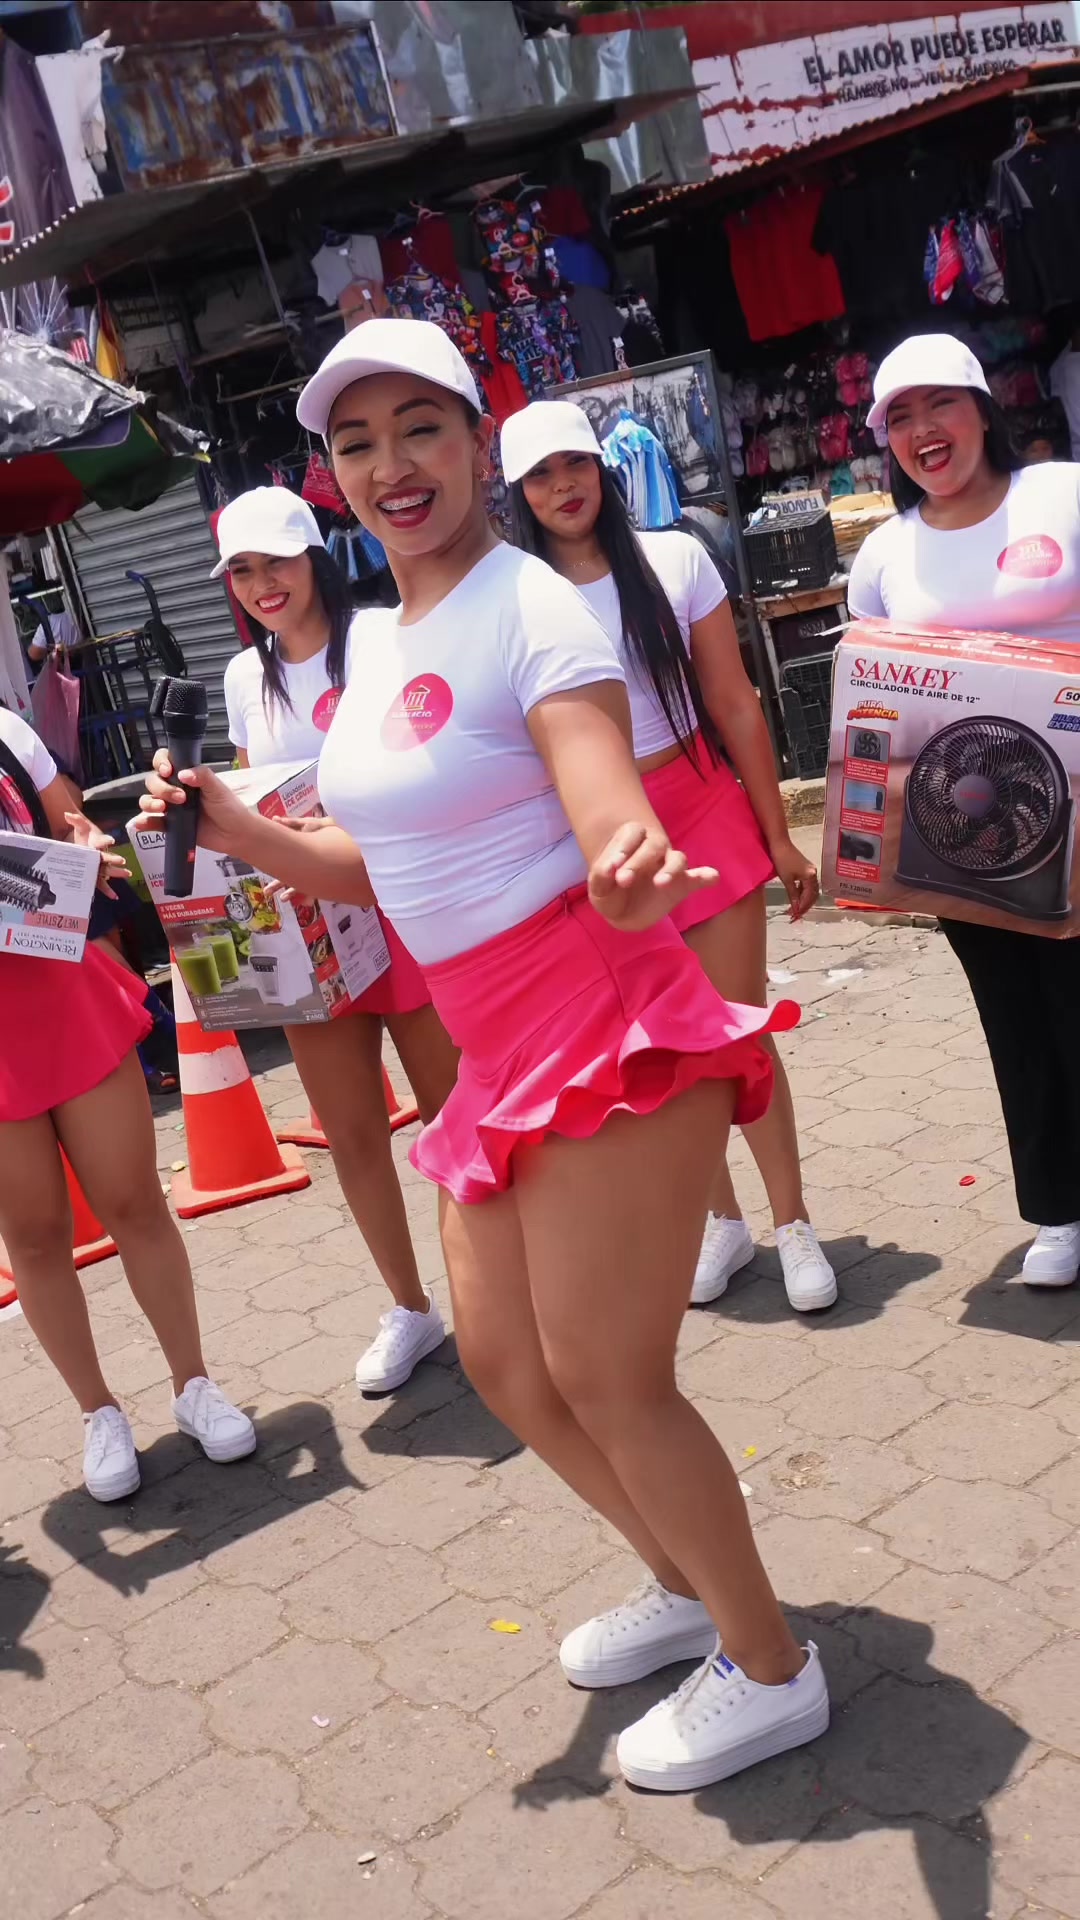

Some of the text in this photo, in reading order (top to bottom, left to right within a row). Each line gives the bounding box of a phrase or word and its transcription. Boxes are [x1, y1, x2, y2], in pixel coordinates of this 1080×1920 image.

[803, 17, 1068, 85] EL AMOR PUEDE ESPERAR
[780, 497, 820, 514] FLAVOR
[850, 657, 958, 691] SANKEY
[850, 679, 910, 695] CIRCULADOR
[912, 688, 924, 697] DE
[926, 690, 948, 700] AIRE
[951, 693, 963, 702] DE
[285, 796, 296, 808] ICE
[141, 832, 166, 845] BLAC
[151, 879, 165, 888] ICE
[14, 937, 77, 956] REMINGTON
